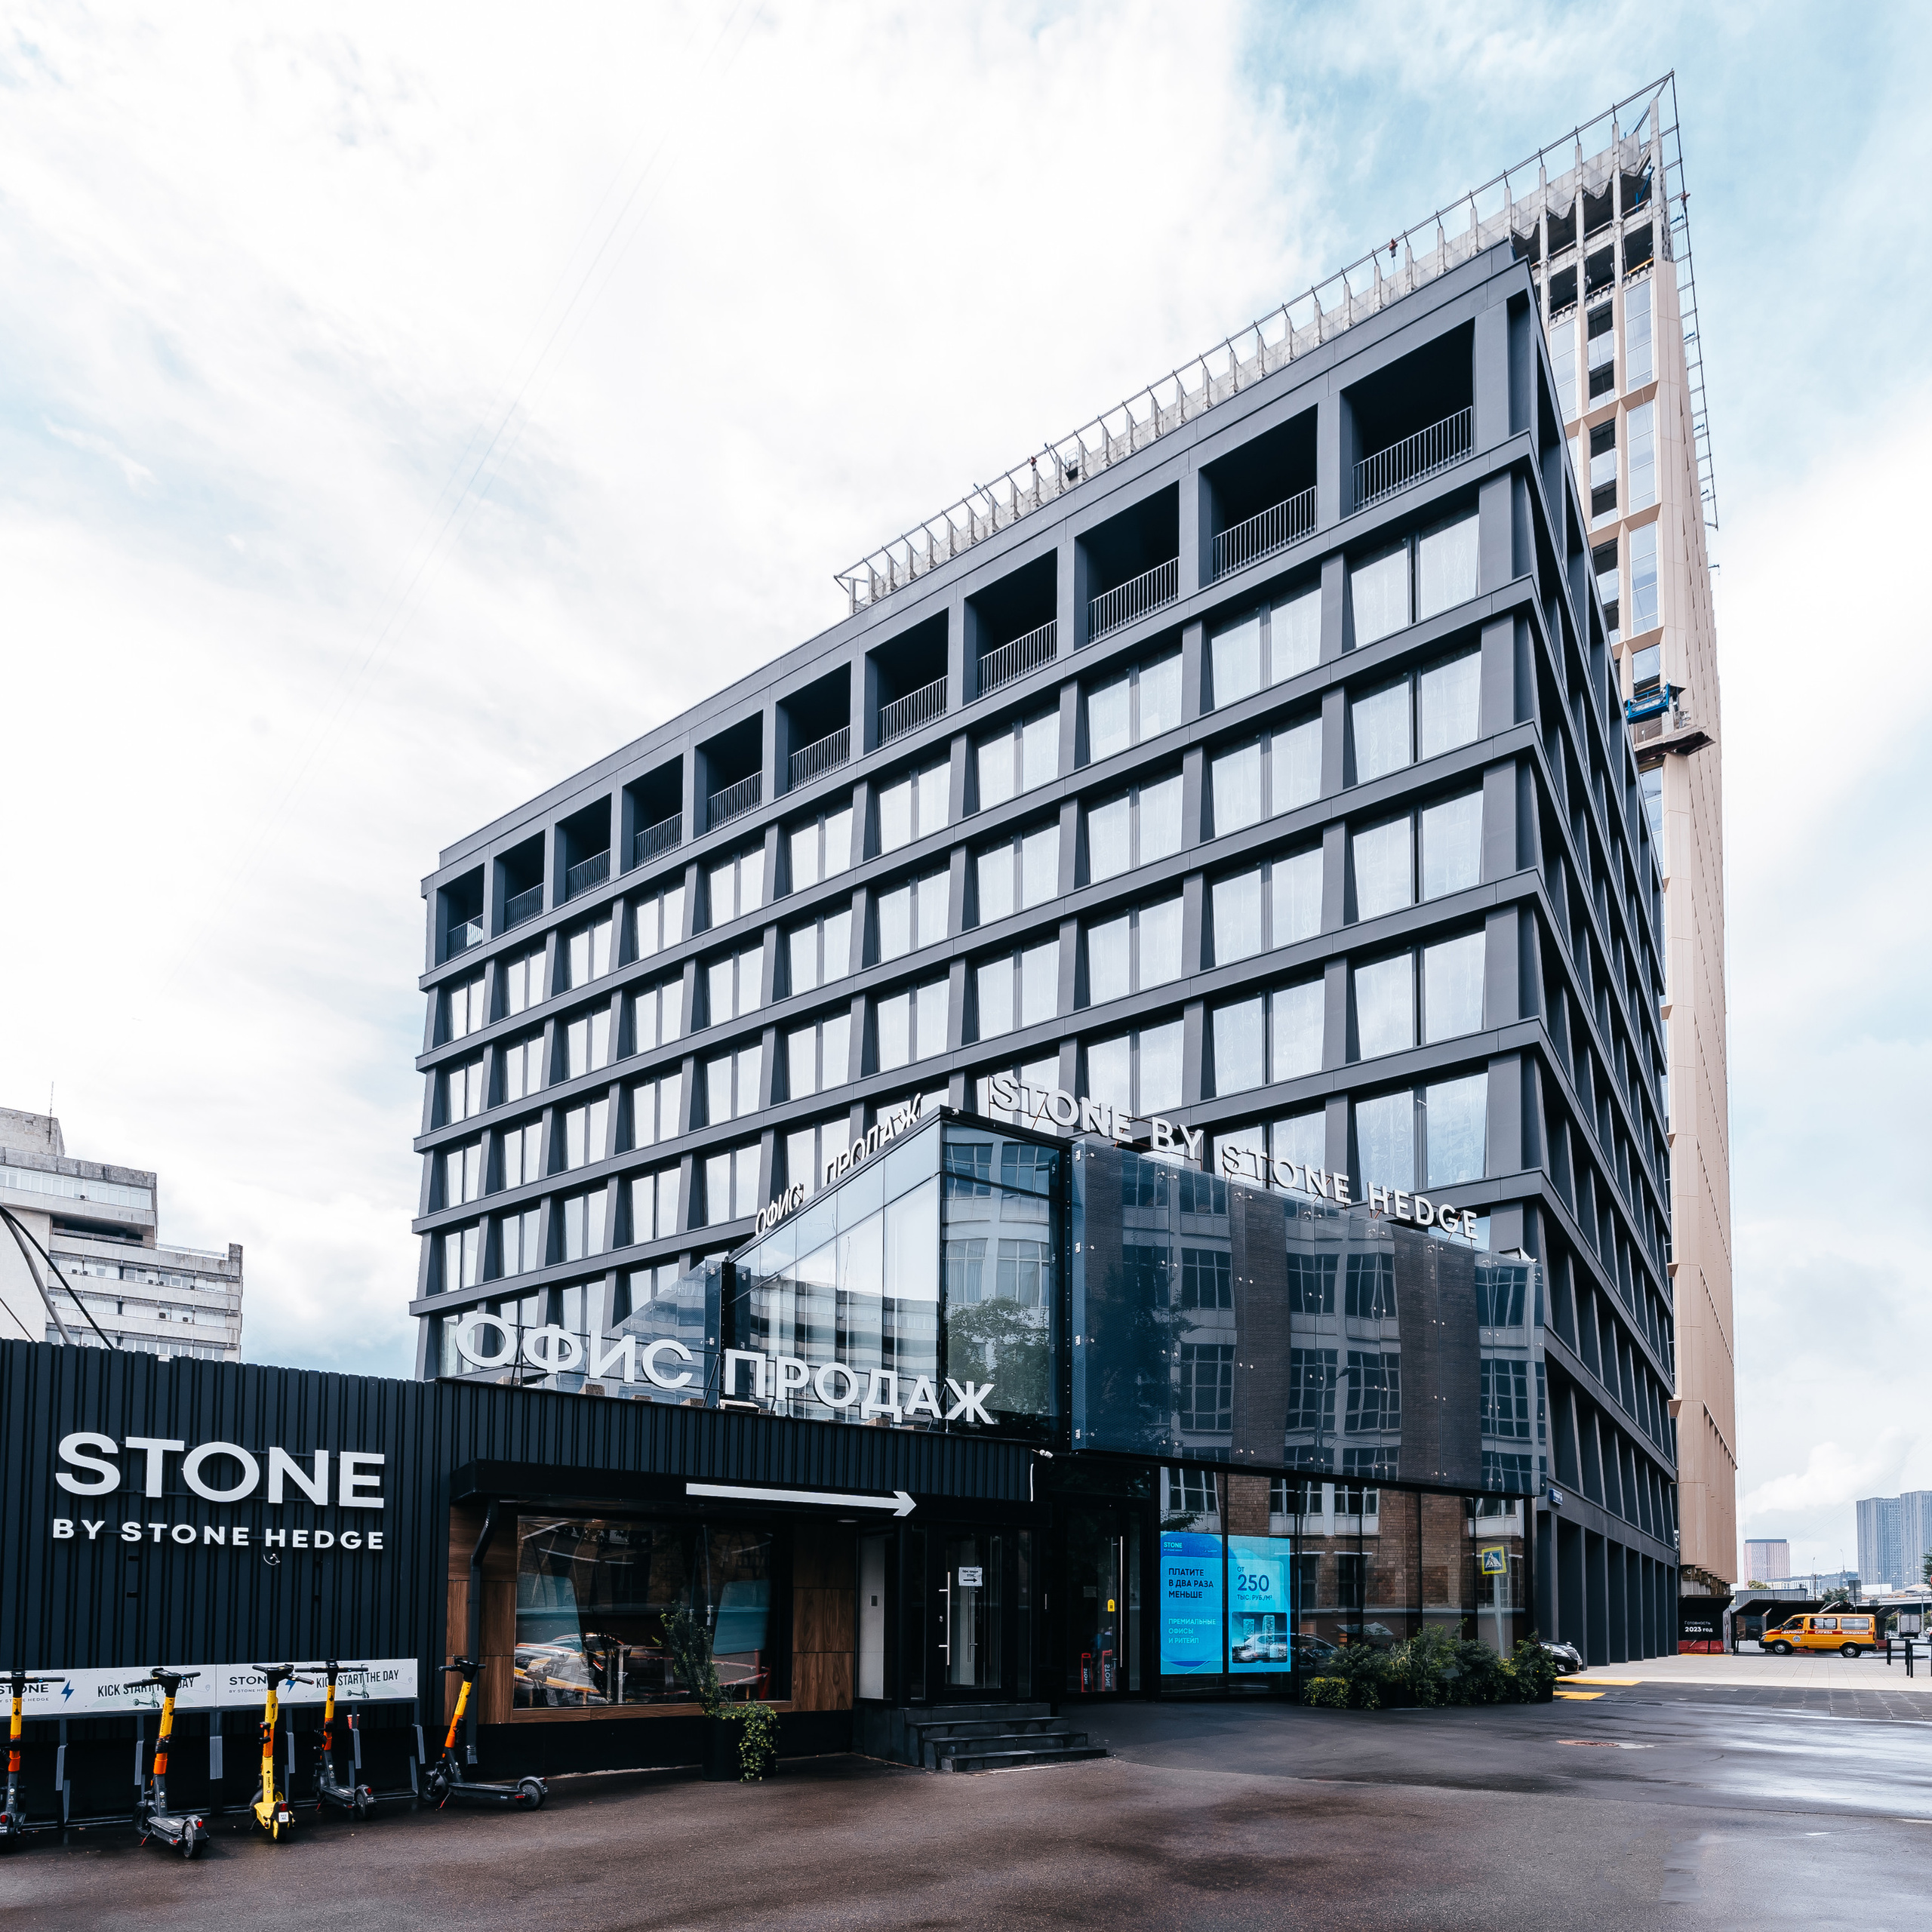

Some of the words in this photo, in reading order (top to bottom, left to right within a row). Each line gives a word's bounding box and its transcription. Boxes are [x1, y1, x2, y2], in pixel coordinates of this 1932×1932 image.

[992, 1072, 1133, 1143] STONE
[1150, 1116, 1204, 1161] BY
[1222, 1143, 1352, 1205] STONE
[1367, 1181, 1478, 1241] HEDGE
[755, 1181, 803, 1236] ОФИС
[454, 1313, 694, 1389] ОФИС
[724, 1348, 995, 1425] ПРОДАЖ
[55, 1432, 385, 1509] STONE
[53, 1518, 106, 1540] BY
[121, 1521, 250, 1546] STONE
[265, 1528, 384, 1550] HEDGE
[1168, 1567, 1204, 1577] ПЛАТИТЕ
[1168, 1579, 1174, 1587] В
[1175, 1579, 1192, 1588] ДВА
[1193, 1580, 1214, 1588] РАЗА
[1238, 1574, 1270, 1592] 250
[1168, 1590, 1203, 1598] МЕНЬШЕ
[1174, 1635, 1199, 1644] РИТЕЙЛ
[229, 1675, 266, 1685] STON
[316, 1676, 329, 1689] KIC
[338, 1672, 363, 1687] START
[365, 1671, 381, 1683] THE
[383, 1669, 399, 1681] DAY
[97, 1684, 121, 1697] KICK
